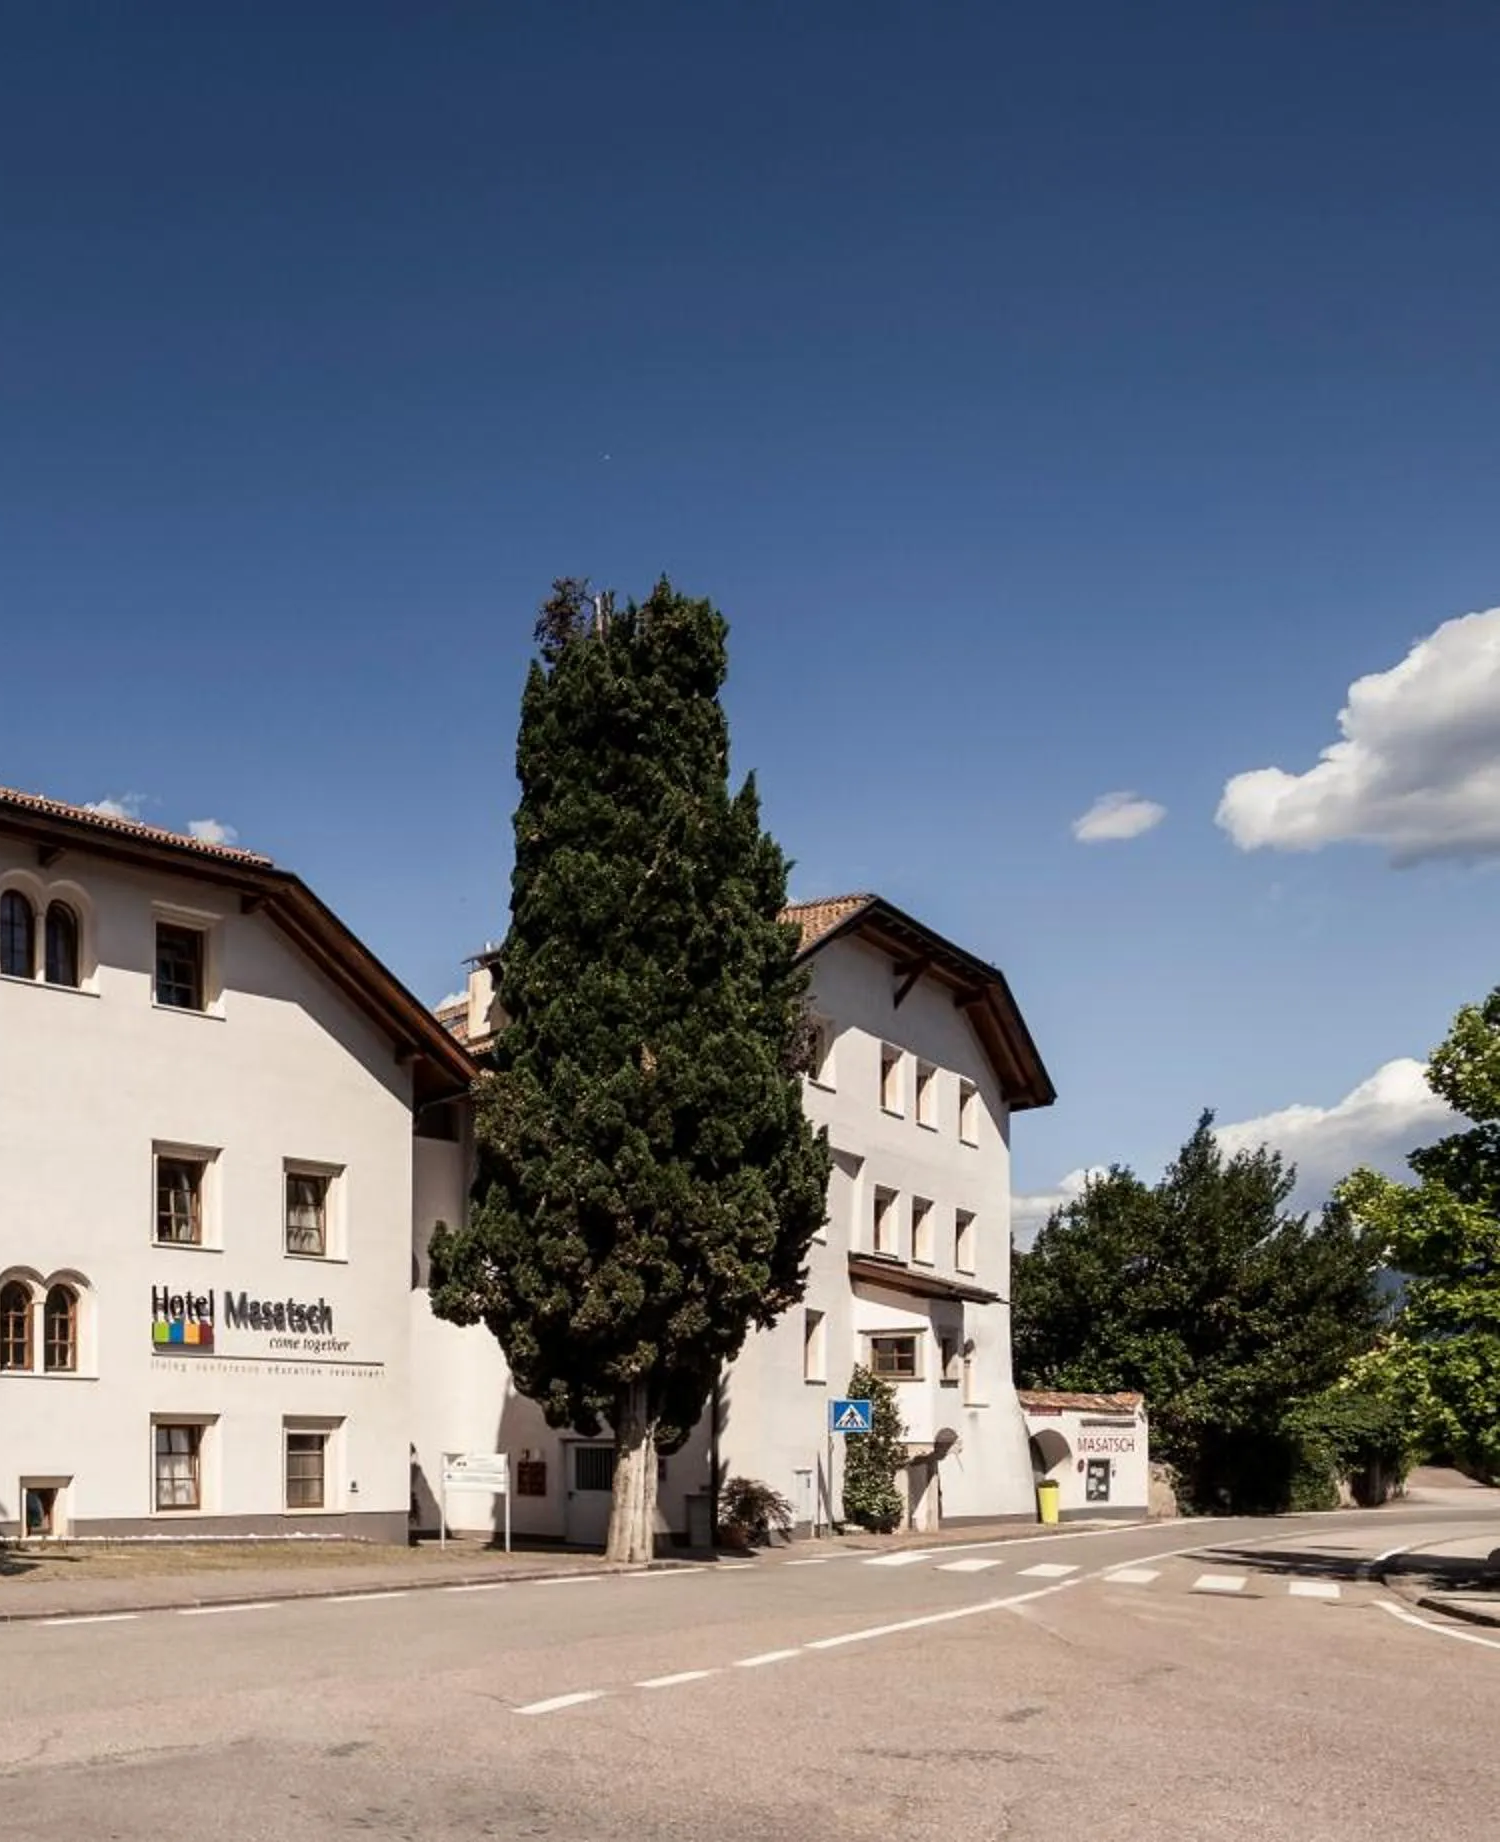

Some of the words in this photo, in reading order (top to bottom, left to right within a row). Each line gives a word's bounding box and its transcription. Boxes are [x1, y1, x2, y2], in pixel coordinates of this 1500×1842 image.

[151, 1285, 214, 1321] Hotel
[224, 1291, 333, 1334] Masatsch
[269, 1338, 299, 1350] come
[303, 1336, 350, 1354] together
[1077, 1436, 1135, 1453] MASATSCH
